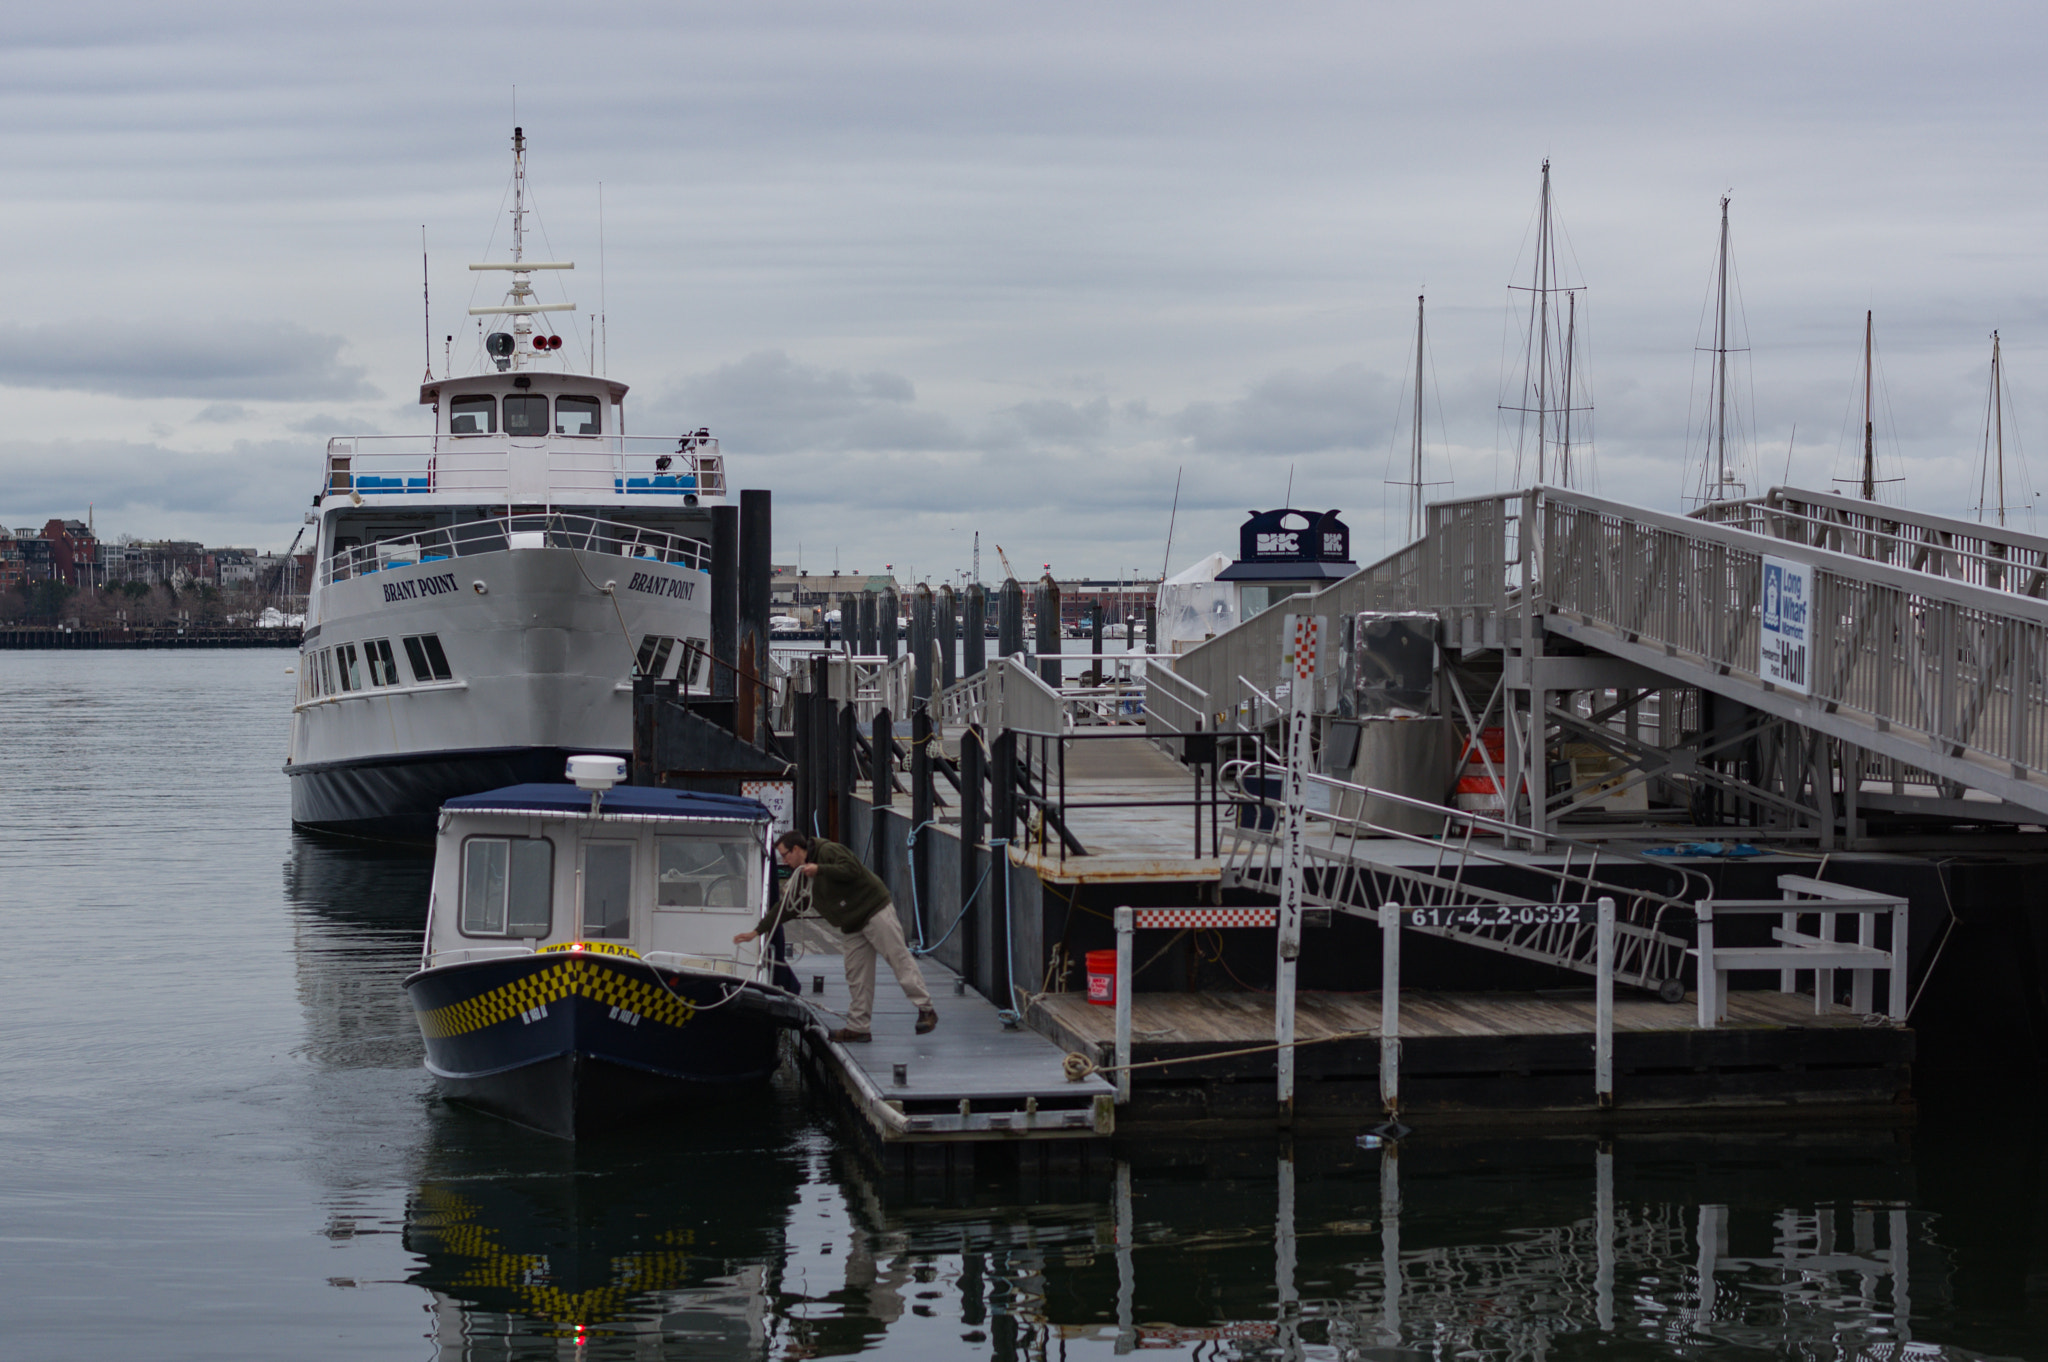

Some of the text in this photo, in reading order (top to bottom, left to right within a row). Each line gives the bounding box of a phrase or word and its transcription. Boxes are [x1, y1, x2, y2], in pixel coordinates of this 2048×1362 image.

[1257, 533, 1299, 551] BHC
[383, 573, 459, 602] BRANT POINT
[628, 572, 695, 600] BRANT POINT
[1783, 568, 1802, 600] Long
[1783, 595, 1807, 624] Wharf
[1782, 620, 1803, 640] Marriott
[1781, 640, 1805, 686] Hull
[546, 943, 592, 953] WATR
